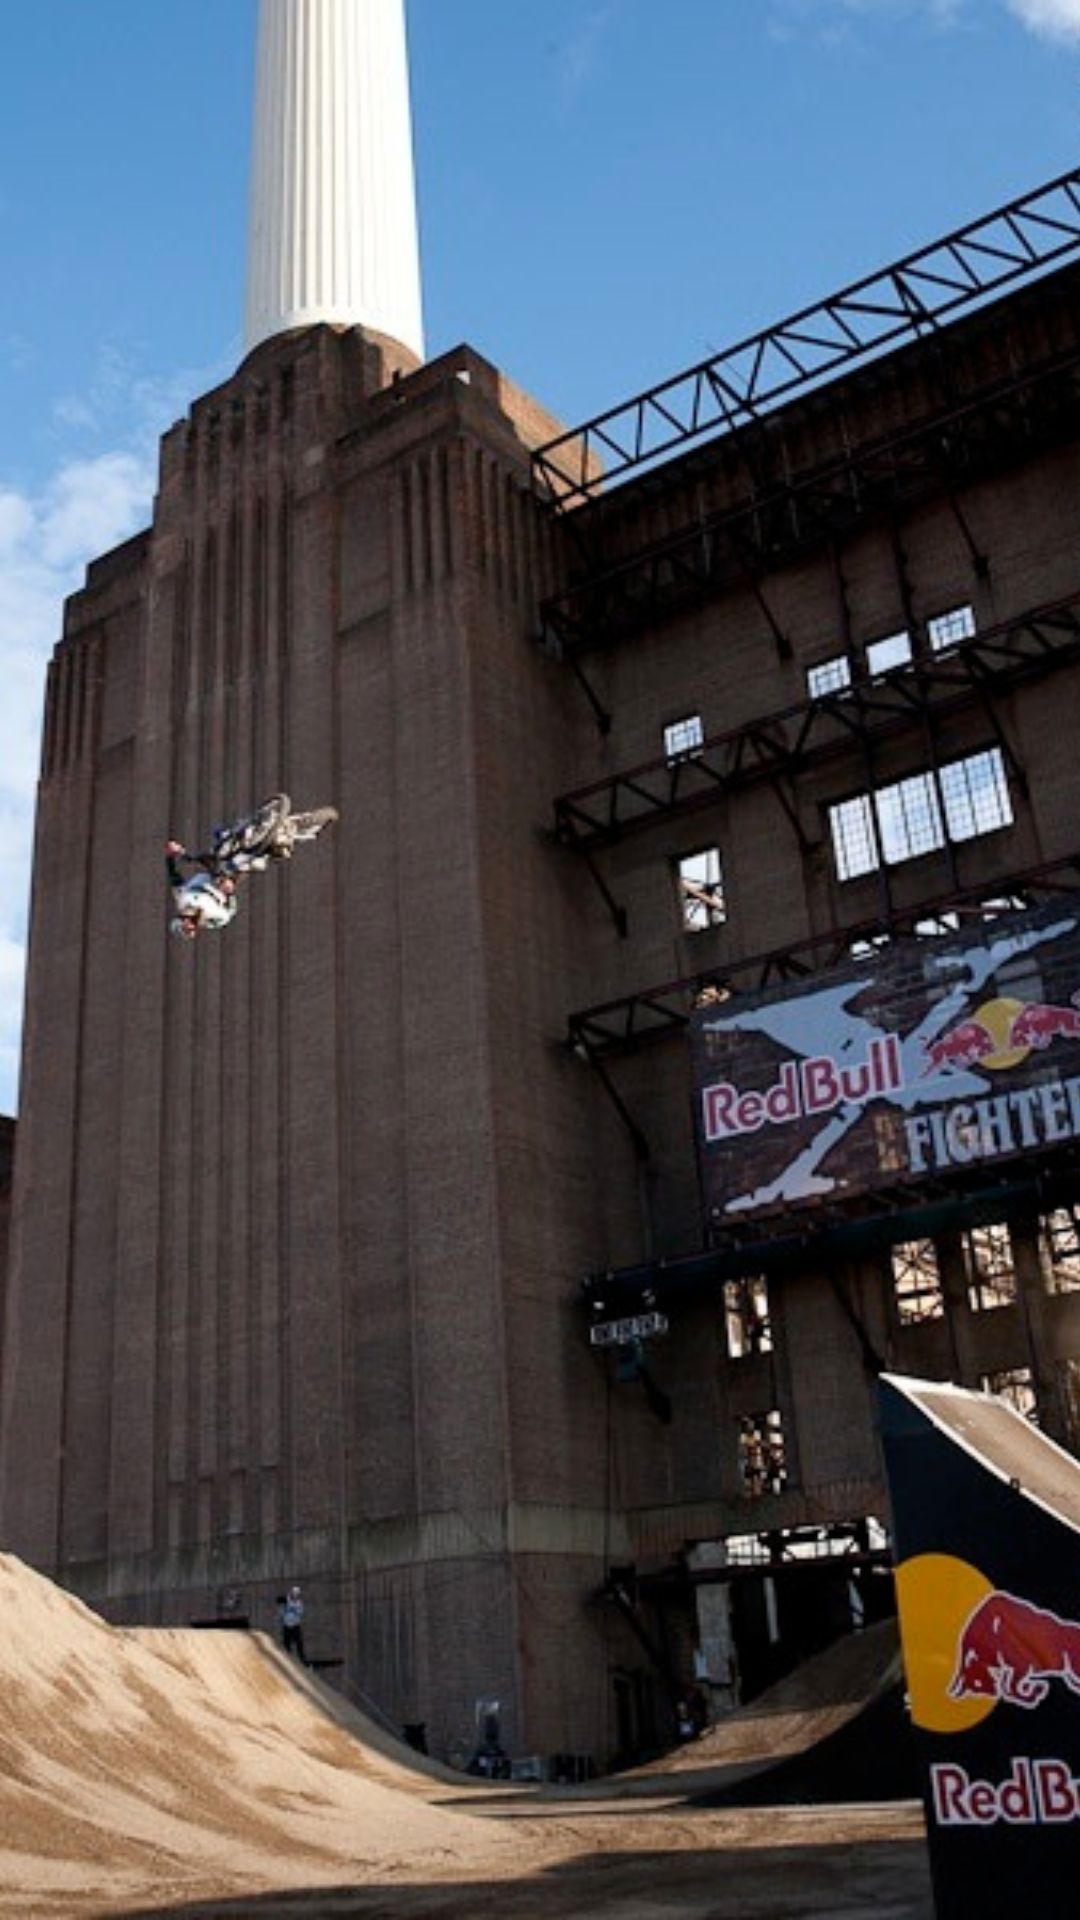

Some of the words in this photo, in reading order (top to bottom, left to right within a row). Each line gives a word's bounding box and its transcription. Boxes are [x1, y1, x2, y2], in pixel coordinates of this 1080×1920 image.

[703, 1061, 801, 1140] Red
[802, 1034, 903, 1115] Bull
[930, 1756, 1037, 1825] Red
[1032, 1760, 1080, 1823] B
